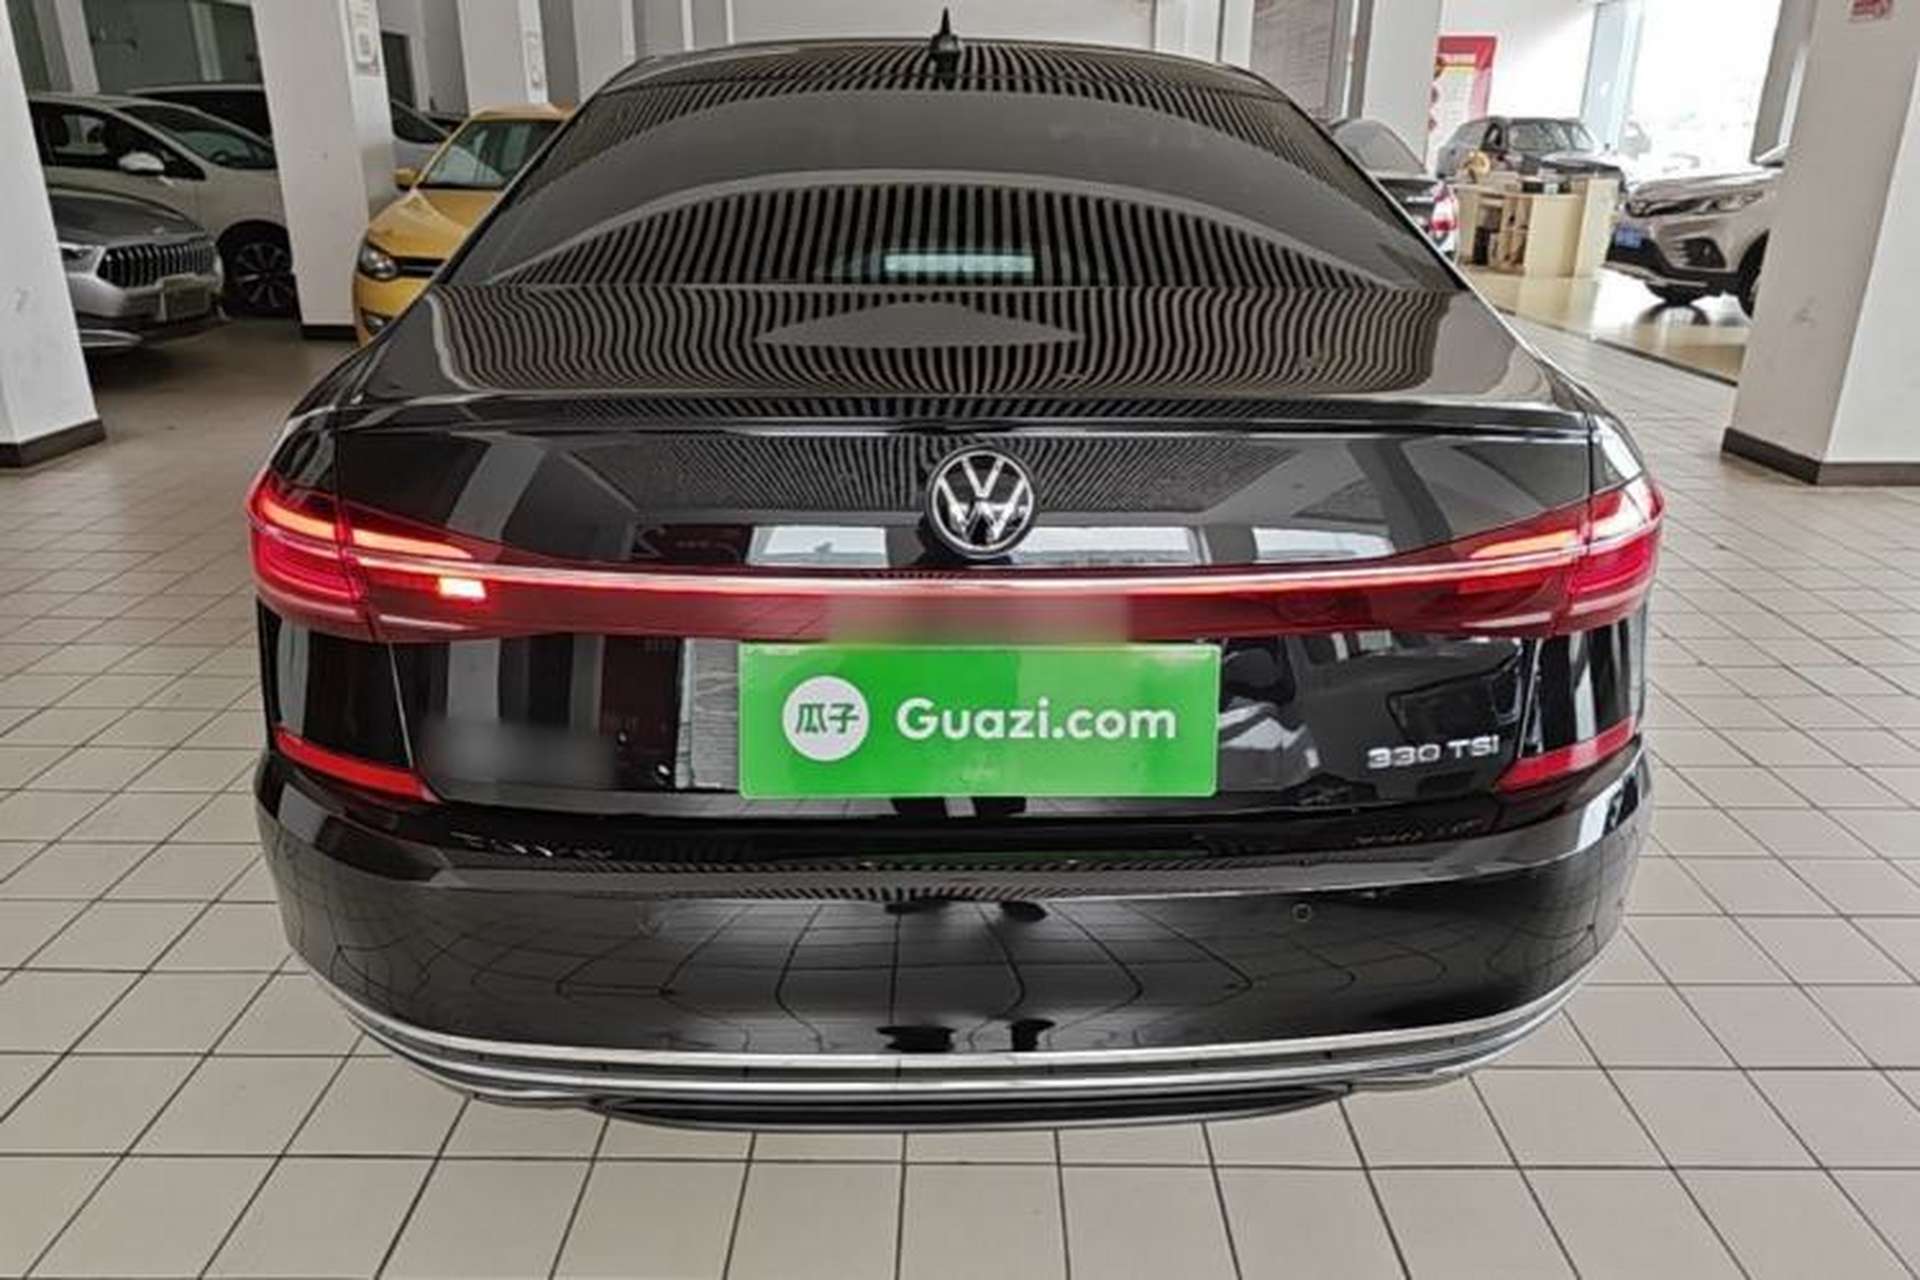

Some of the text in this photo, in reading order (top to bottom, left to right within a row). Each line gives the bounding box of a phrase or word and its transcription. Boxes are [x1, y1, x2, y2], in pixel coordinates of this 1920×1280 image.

[795, 702, 860, 735] 瓜子
[896, 696, 1177, 740] Guazi.com
[1367, 734, 1500, 769] 330 TSI
